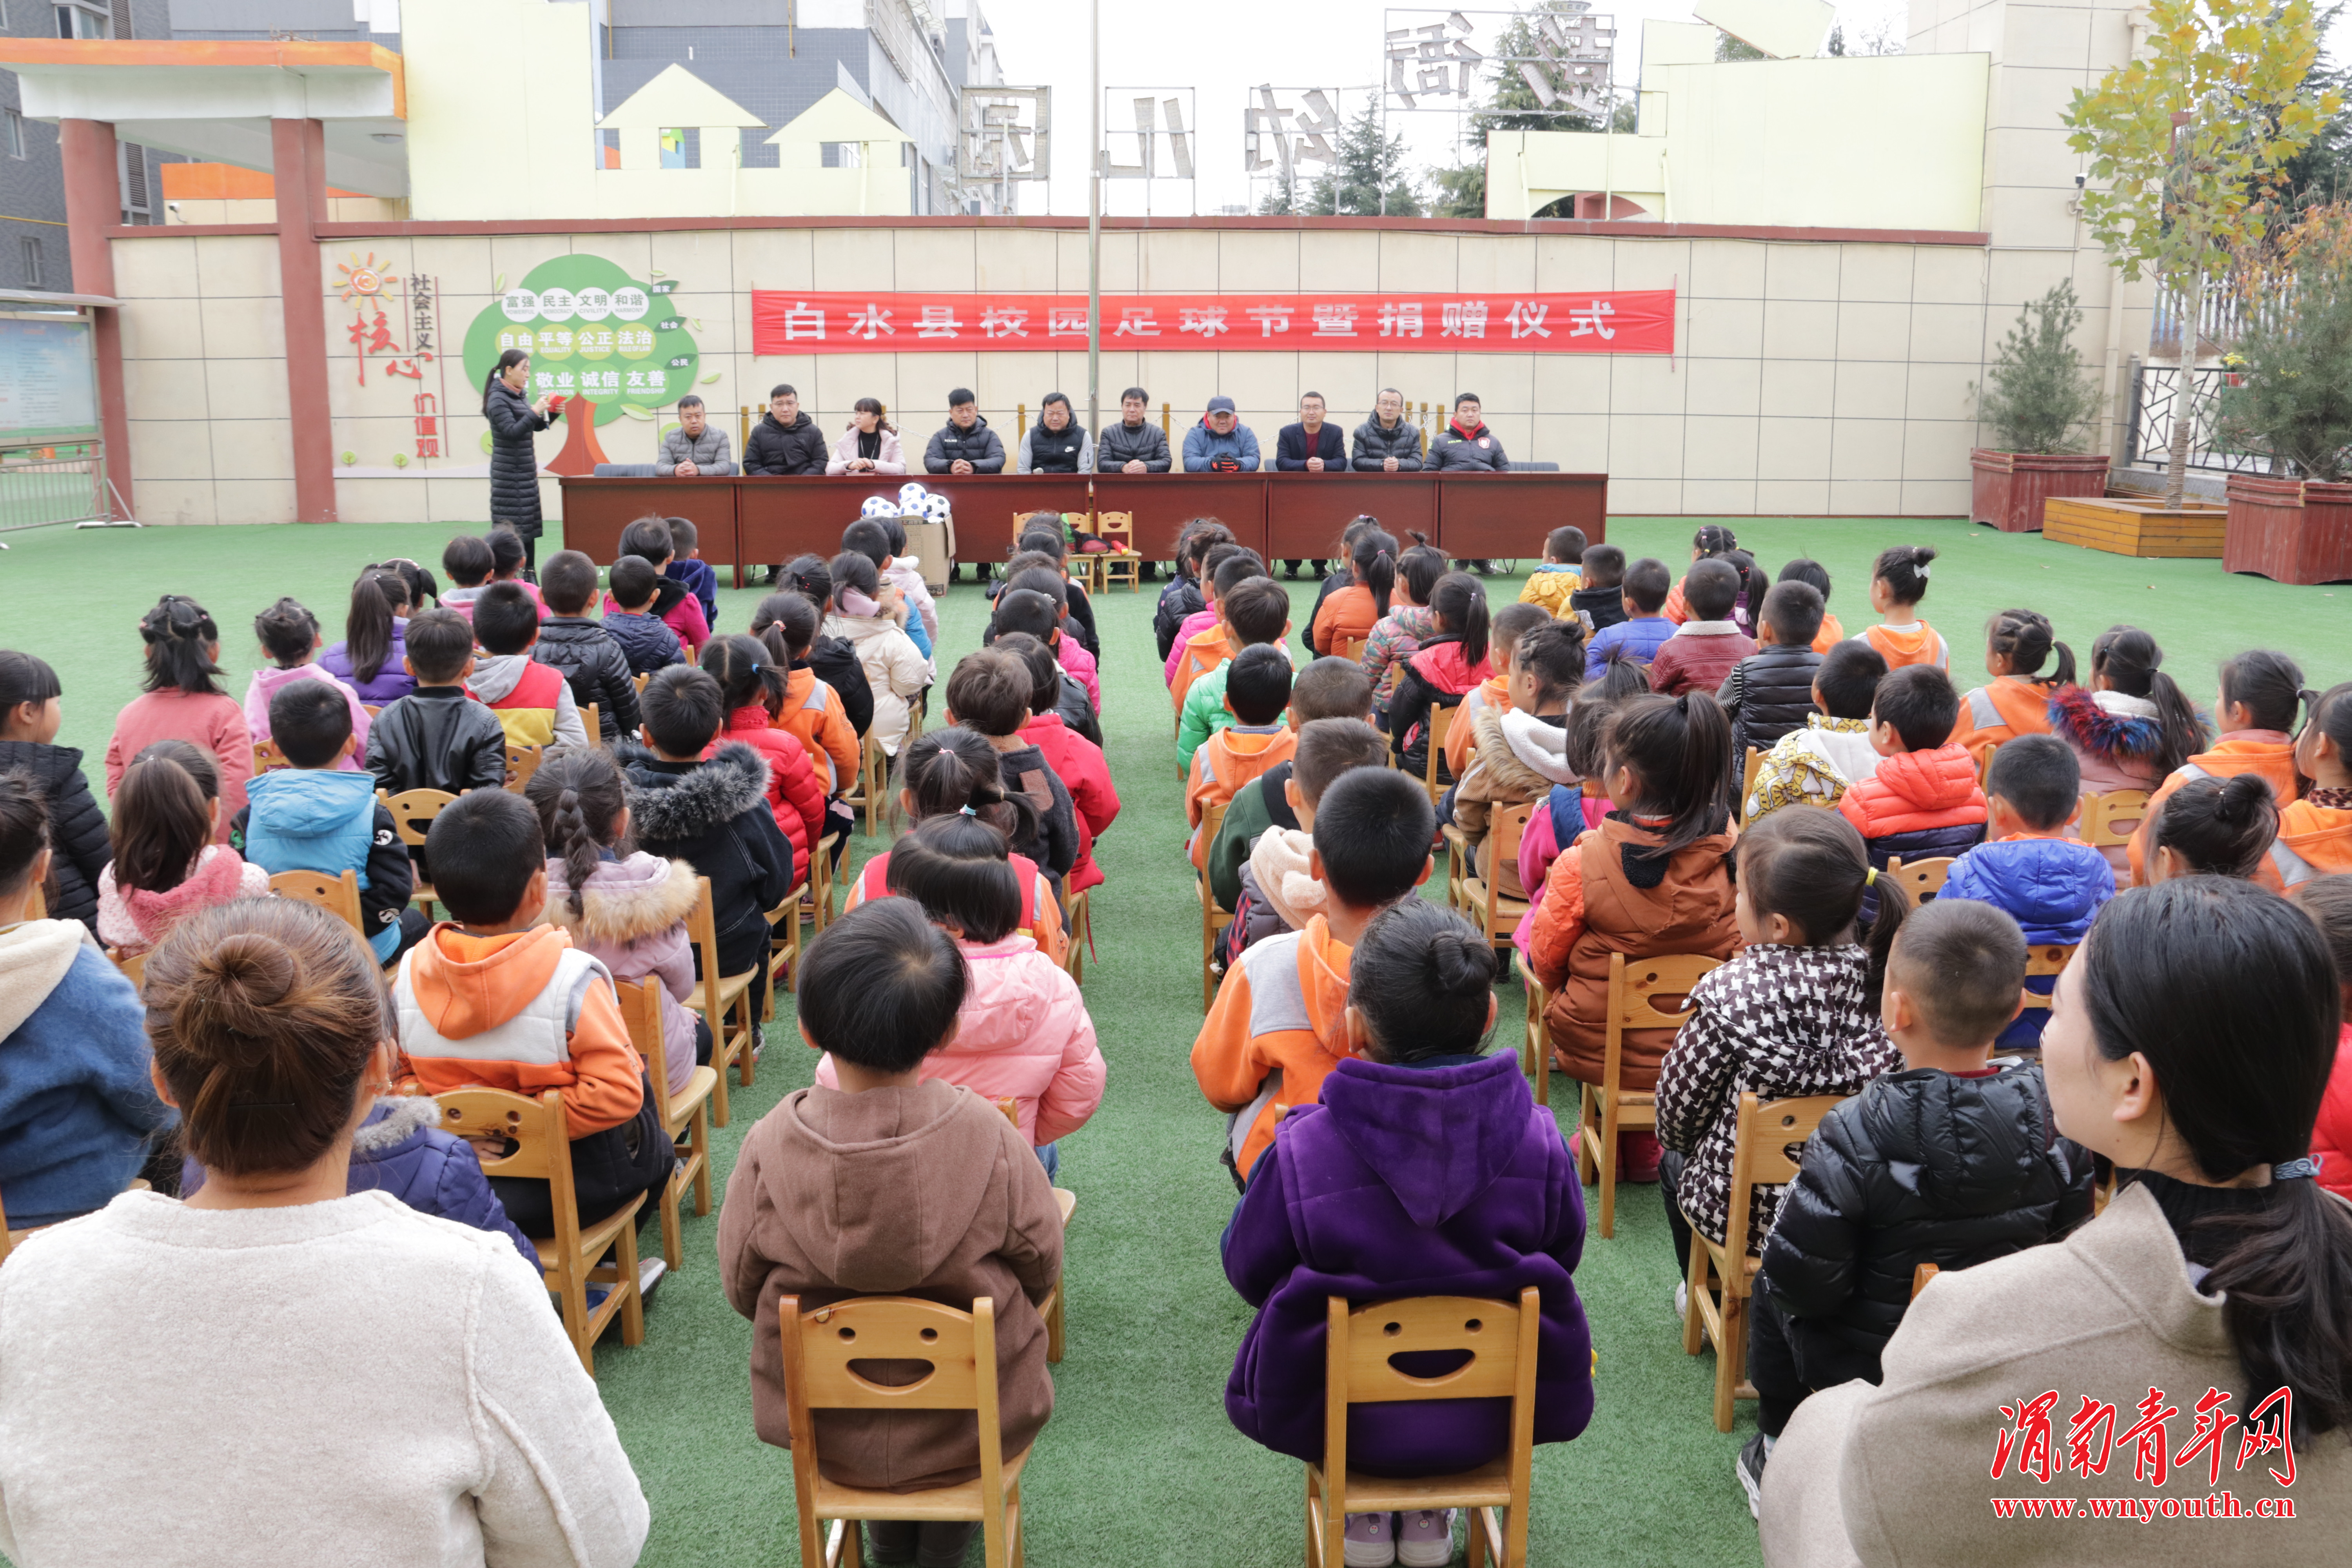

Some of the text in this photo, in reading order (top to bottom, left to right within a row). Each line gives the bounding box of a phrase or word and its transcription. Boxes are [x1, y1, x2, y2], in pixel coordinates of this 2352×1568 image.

[410, 273, 434, 350] 社会主义
[506, 294, 643, 308] 富强 民主 文明 和谐
[785, 300, 1615, 340] 白水县校园足球节暨捐赠仪式
[501, 330, 652, 347] 自由 平等 公正 法治
[535, 372, 575, 388] 敬业
[580, 371, 620, 387] 诚信
[626, 370, 666, 387] 友善
[414, 393, 440, 458] 价值观
